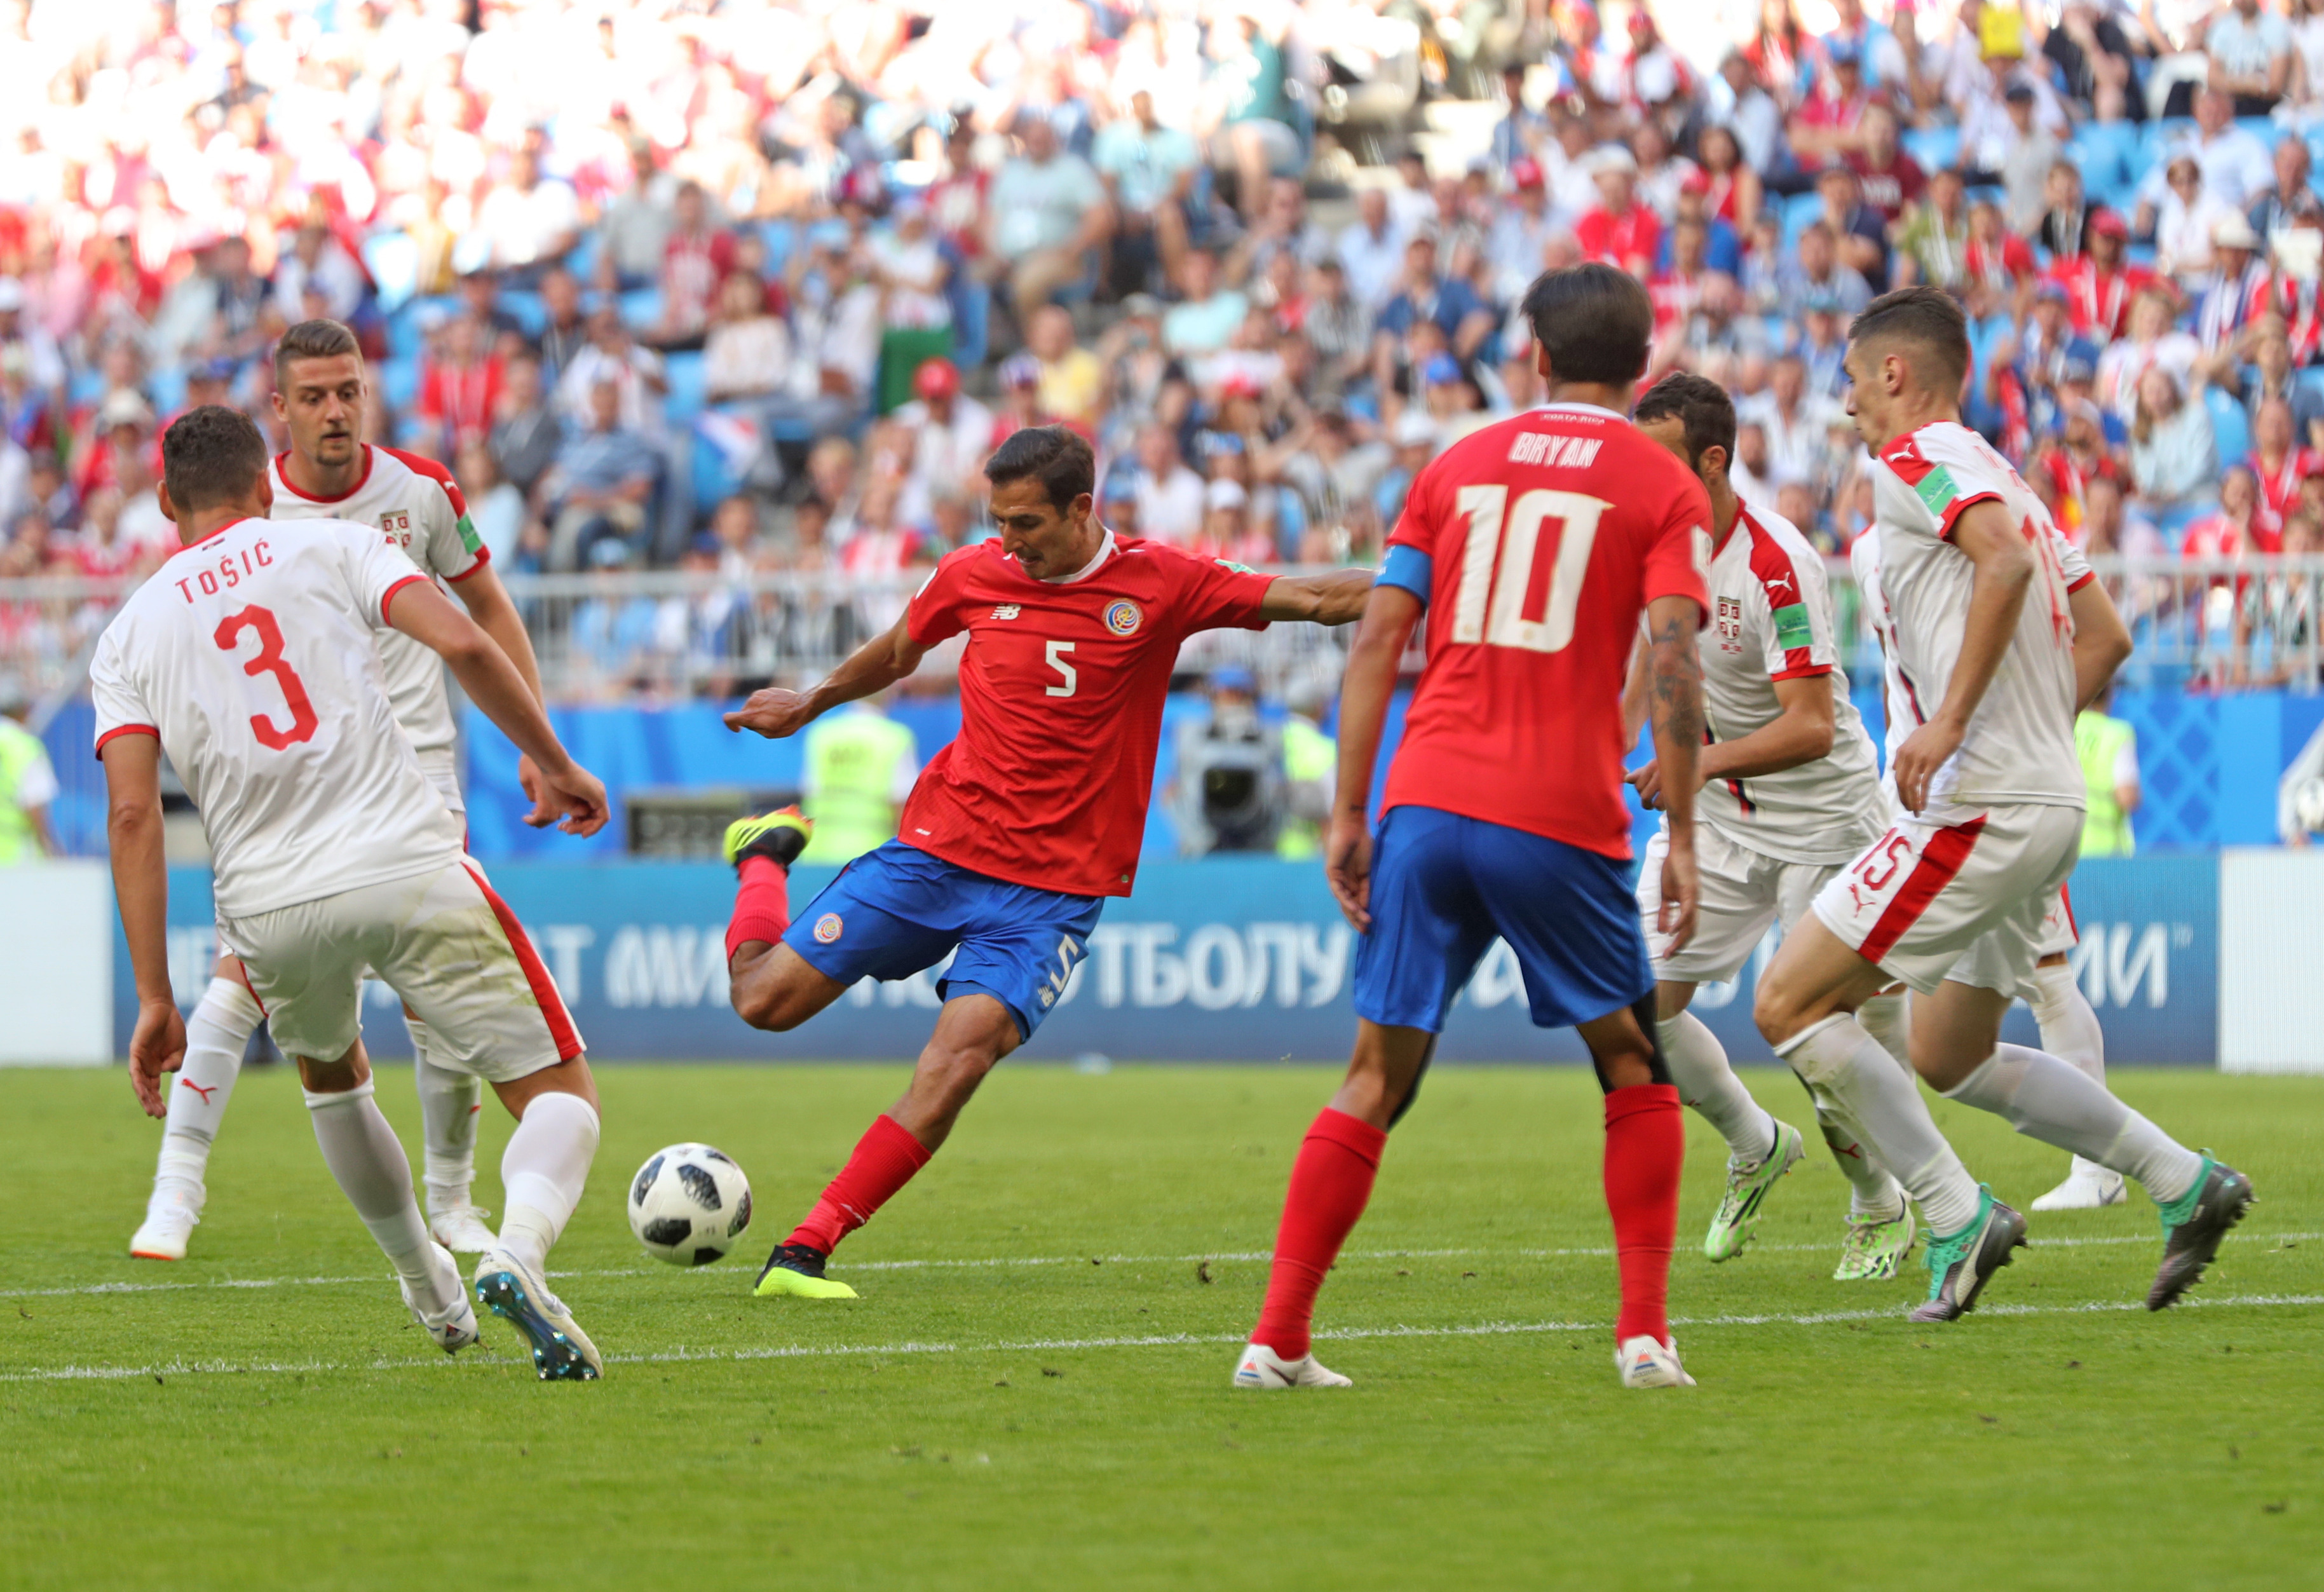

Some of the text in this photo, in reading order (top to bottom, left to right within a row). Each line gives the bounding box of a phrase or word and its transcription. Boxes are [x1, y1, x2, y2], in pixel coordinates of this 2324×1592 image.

[1508, 431, 1603, 469] BRYAN
[1540, 414, 1606, 426] COSTA RICA
[175, 538, 273, 604] TOŠIĆ
[1451, 484, 1617, 654] 10
[214, 604, 319, 751] 3
[1045, 641, 1077, 698] 5
[1852, 827, 1913, 891] 15
[1049, 933, 1080, 993] 5
